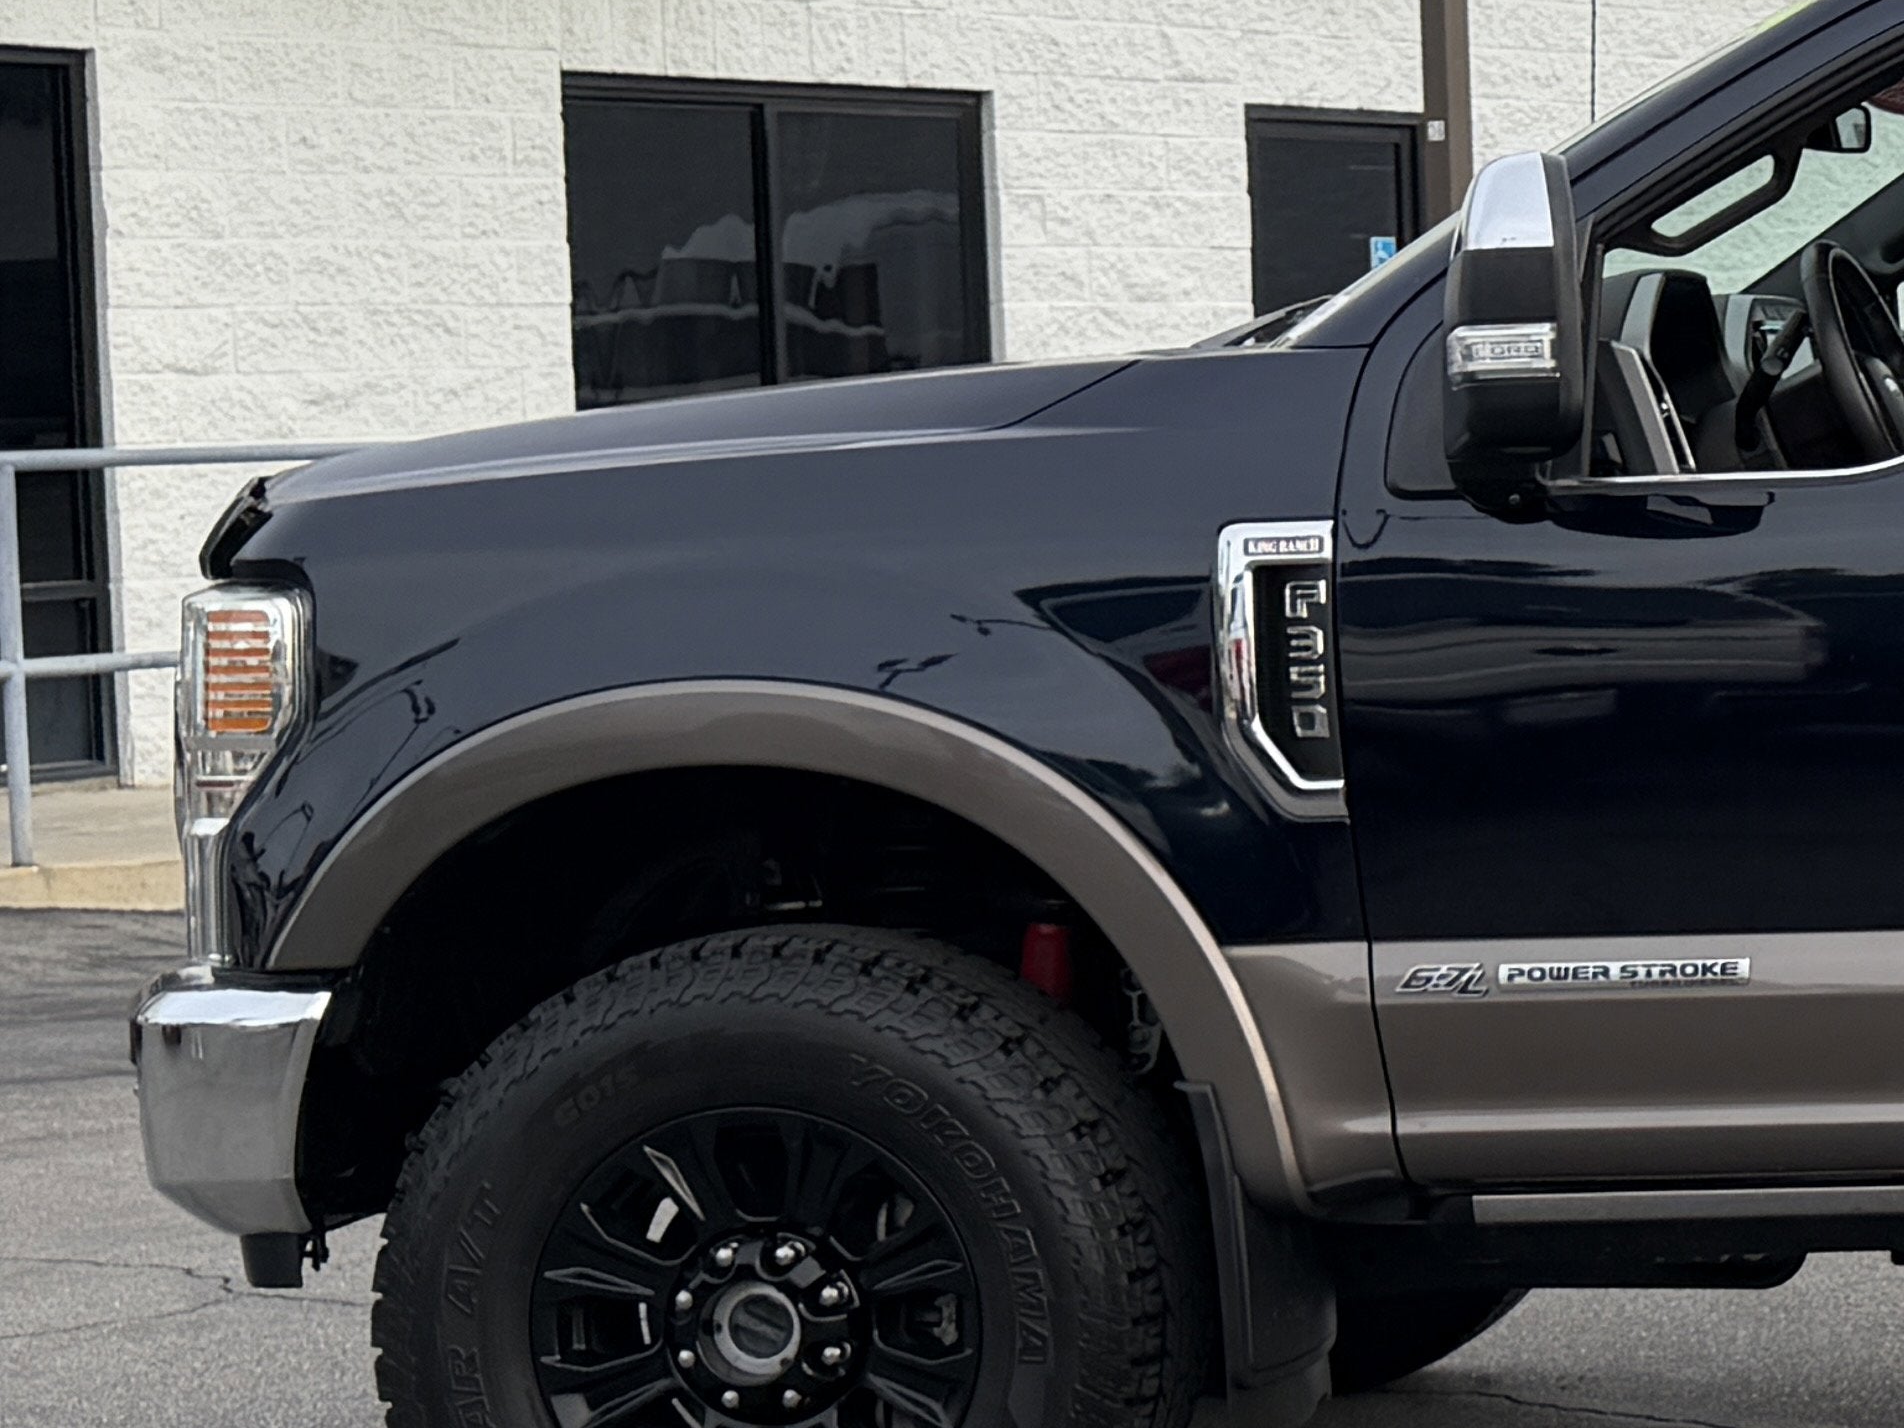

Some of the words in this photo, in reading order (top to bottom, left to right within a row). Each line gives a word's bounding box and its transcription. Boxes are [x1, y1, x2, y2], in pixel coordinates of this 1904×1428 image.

[1395, 962, 1490, 998] 6.7L
[1506, 965, 1610, 983] POWER
[1619, 961, 1740, 980] STROKE
